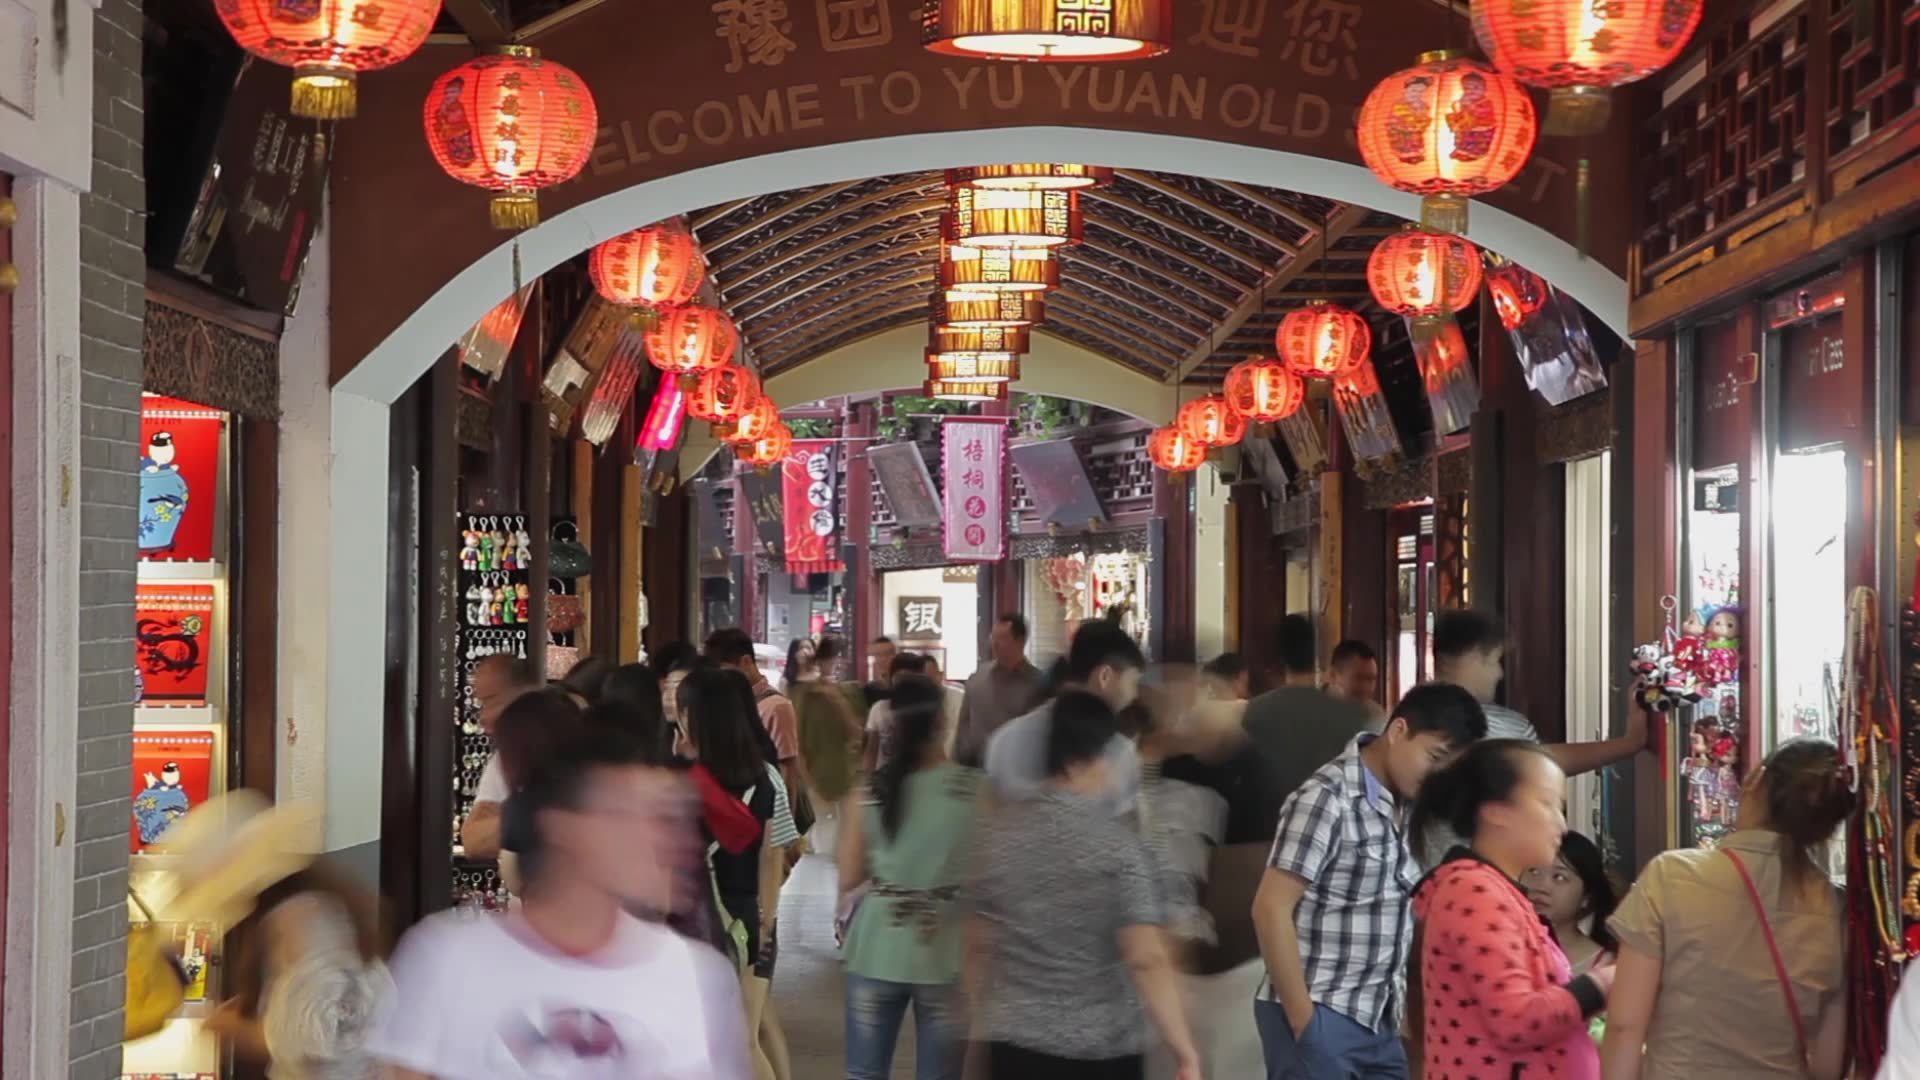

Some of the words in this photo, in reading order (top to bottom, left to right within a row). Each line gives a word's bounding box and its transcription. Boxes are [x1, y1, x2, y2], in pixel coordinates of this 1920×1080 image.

[550, 83, 825, 191] ELCOME
[840, 71, 921, 119] TO
[944, 64, 1024, 110] YU
[1046, 64, 1207, 120] YUAN
[1219, 84, 1330, 139] OLD
[904, 601, 942, 634] 银
